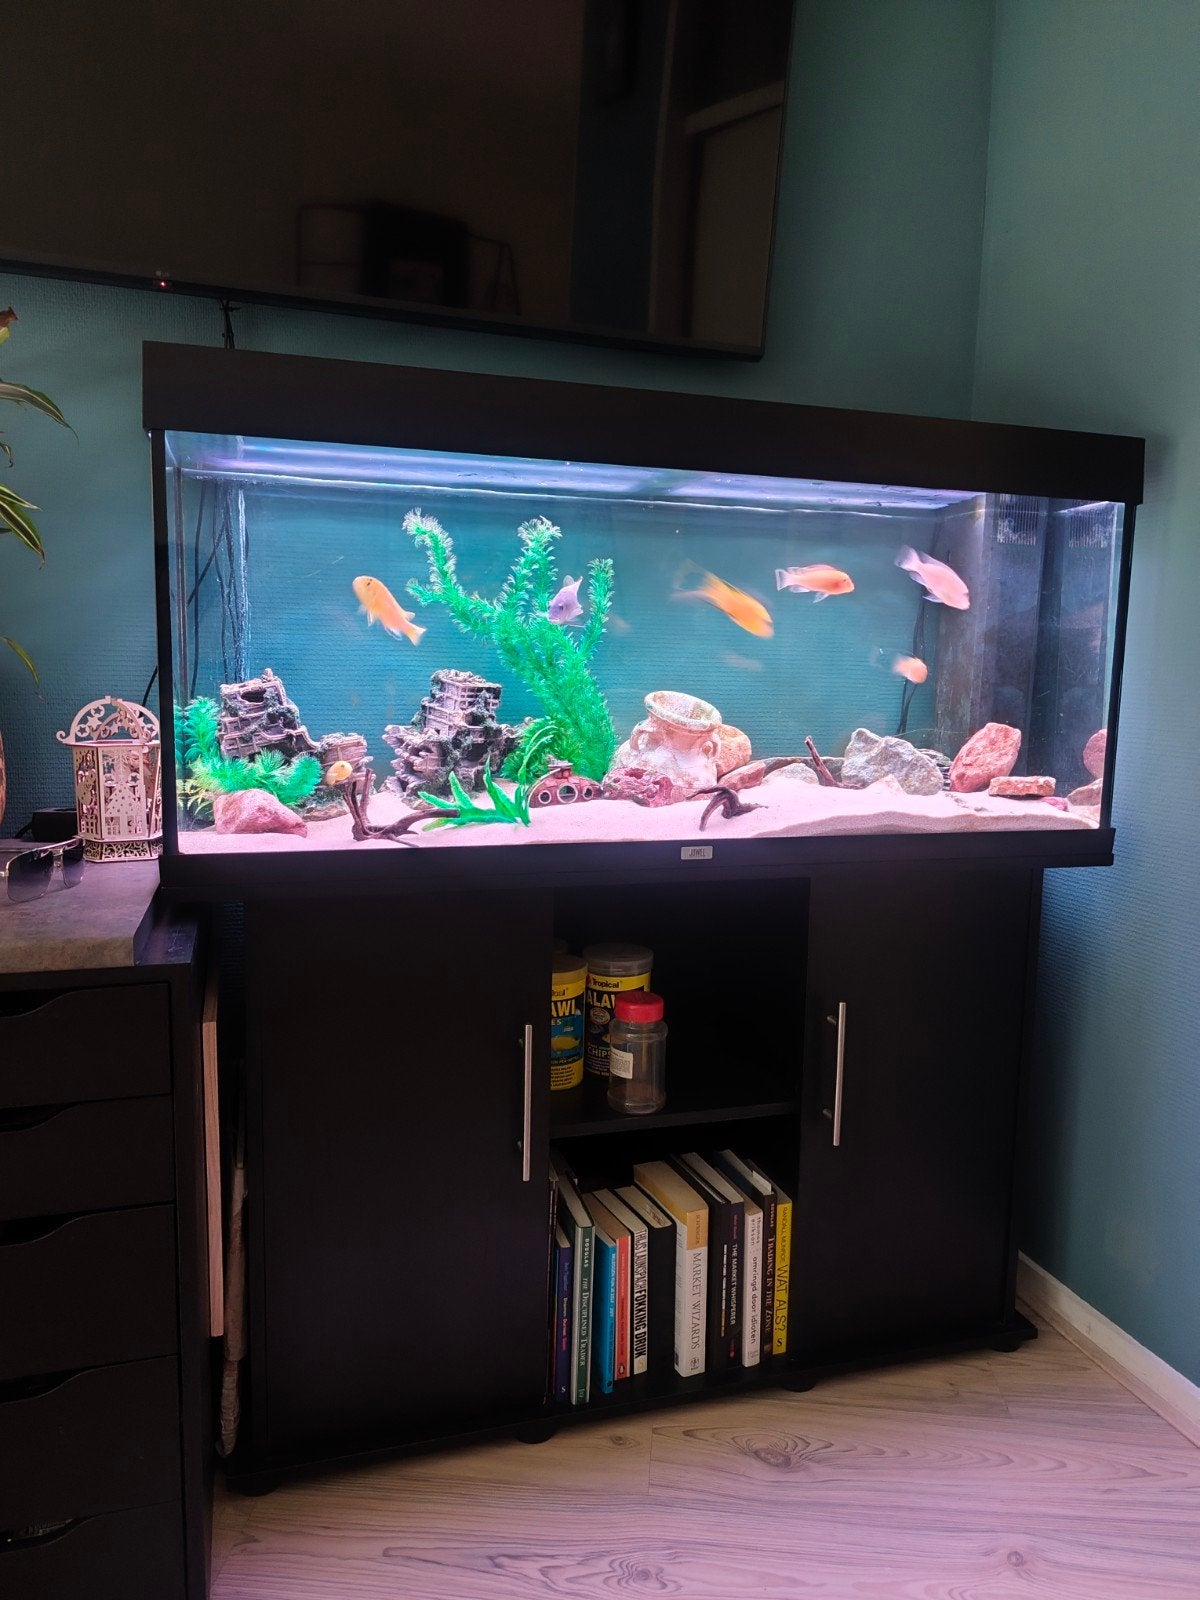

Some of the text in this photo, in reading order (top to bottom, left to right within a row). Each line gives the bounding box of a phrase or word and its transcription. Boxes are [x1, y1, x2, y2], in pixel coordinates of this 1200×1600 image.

[592, 978, 620, 989] Tropical
[692, 1252, 702, 1298] MARKET
[750, 1256, 758, 1292] omringd
[765, 1236, 775, 1333] TRADING IN THE ZONE
[634, 1289, 647, 1332] FOKKING
[776, 1264, 788, 1331] WAT ALS?
[579, 1278, 591, 1367] THE DISCIPLINED TRADER
[691, 1300, 701, 1350] WIZARDS
[750, 1314, 758, 1344] idioten
[634, 1331, 647, 1359] DRUK
